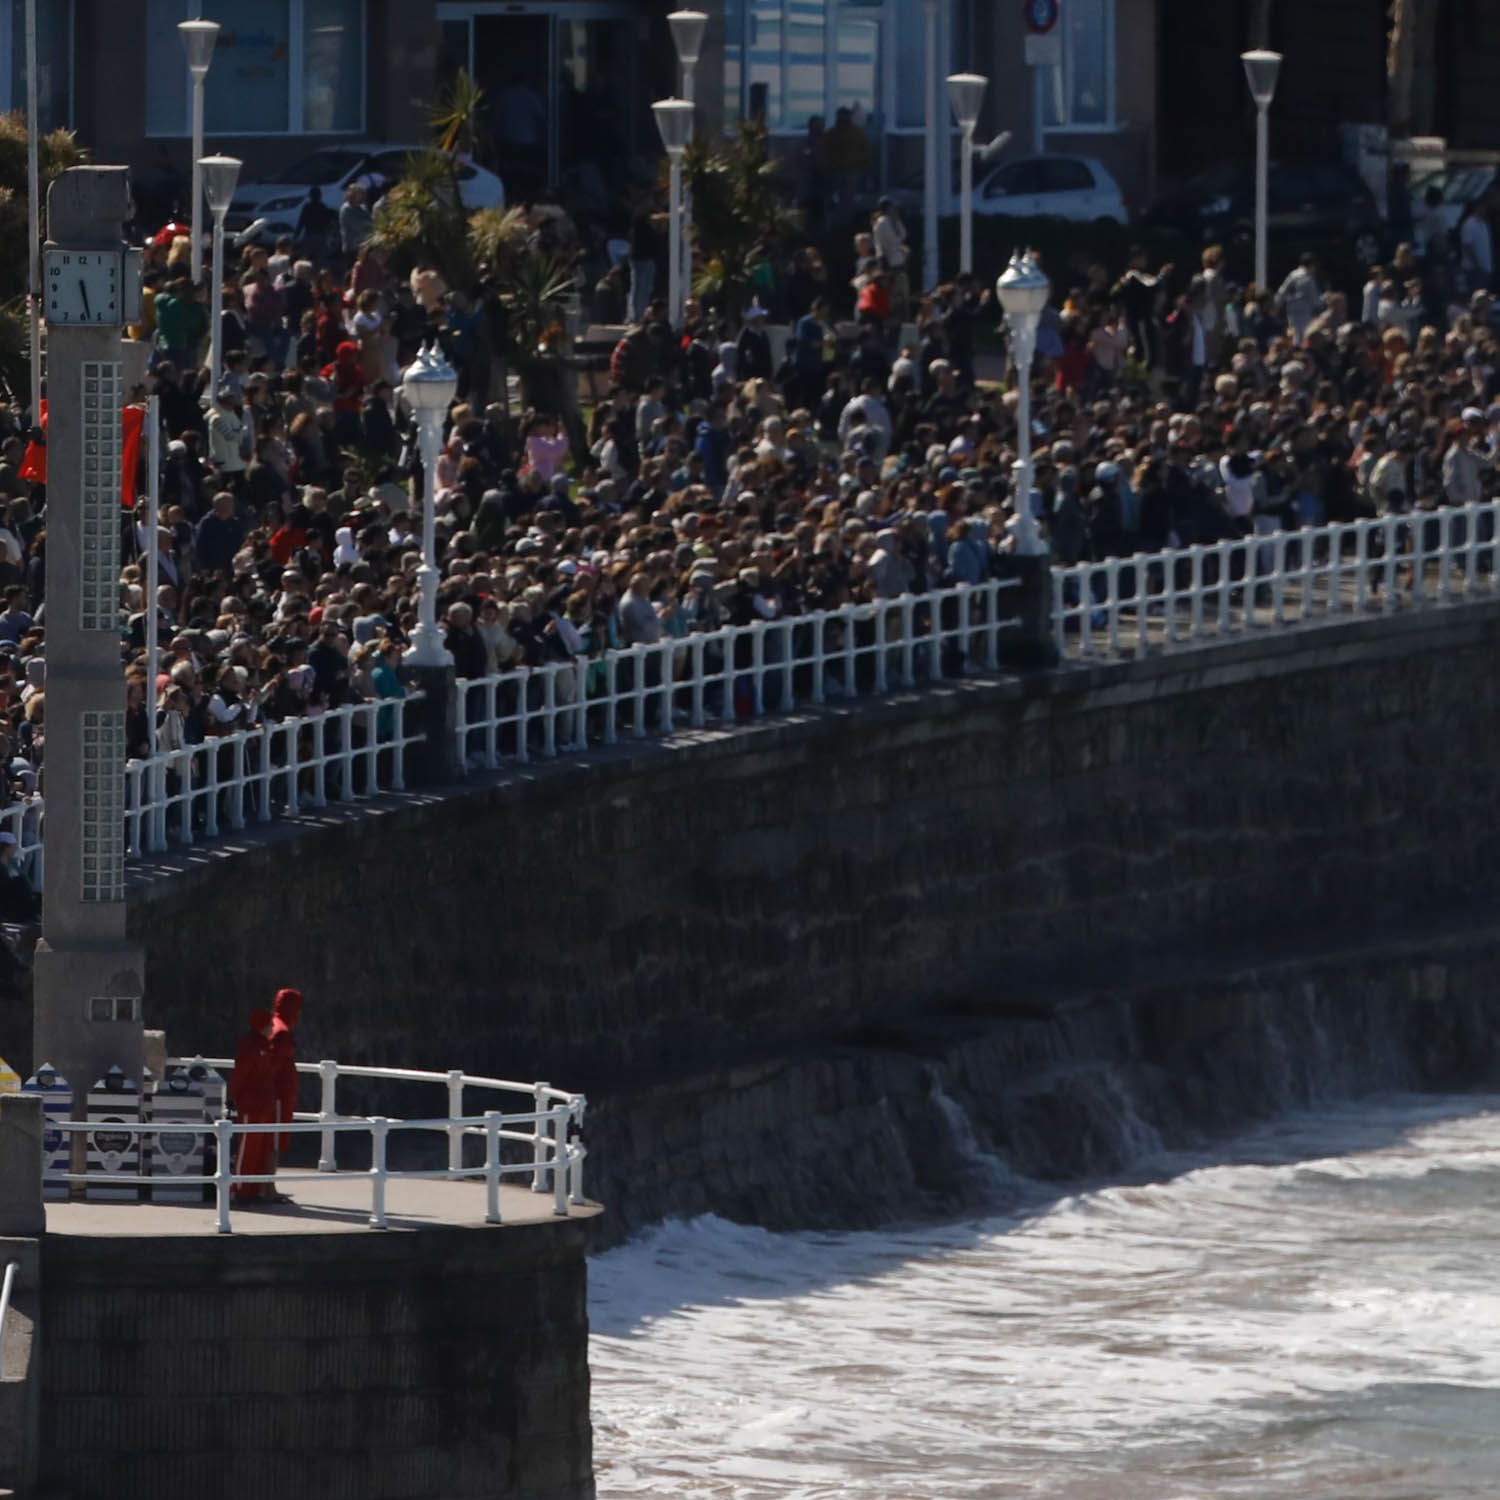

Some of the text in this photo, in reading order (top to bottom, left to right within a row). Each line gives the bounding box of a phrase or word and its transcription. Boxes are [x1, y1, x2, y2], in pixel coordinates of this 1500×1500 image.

[63, 256, 70, 265] 11
[78, 256, 88, 265] 12
[50, 268, 61, 276] 10
